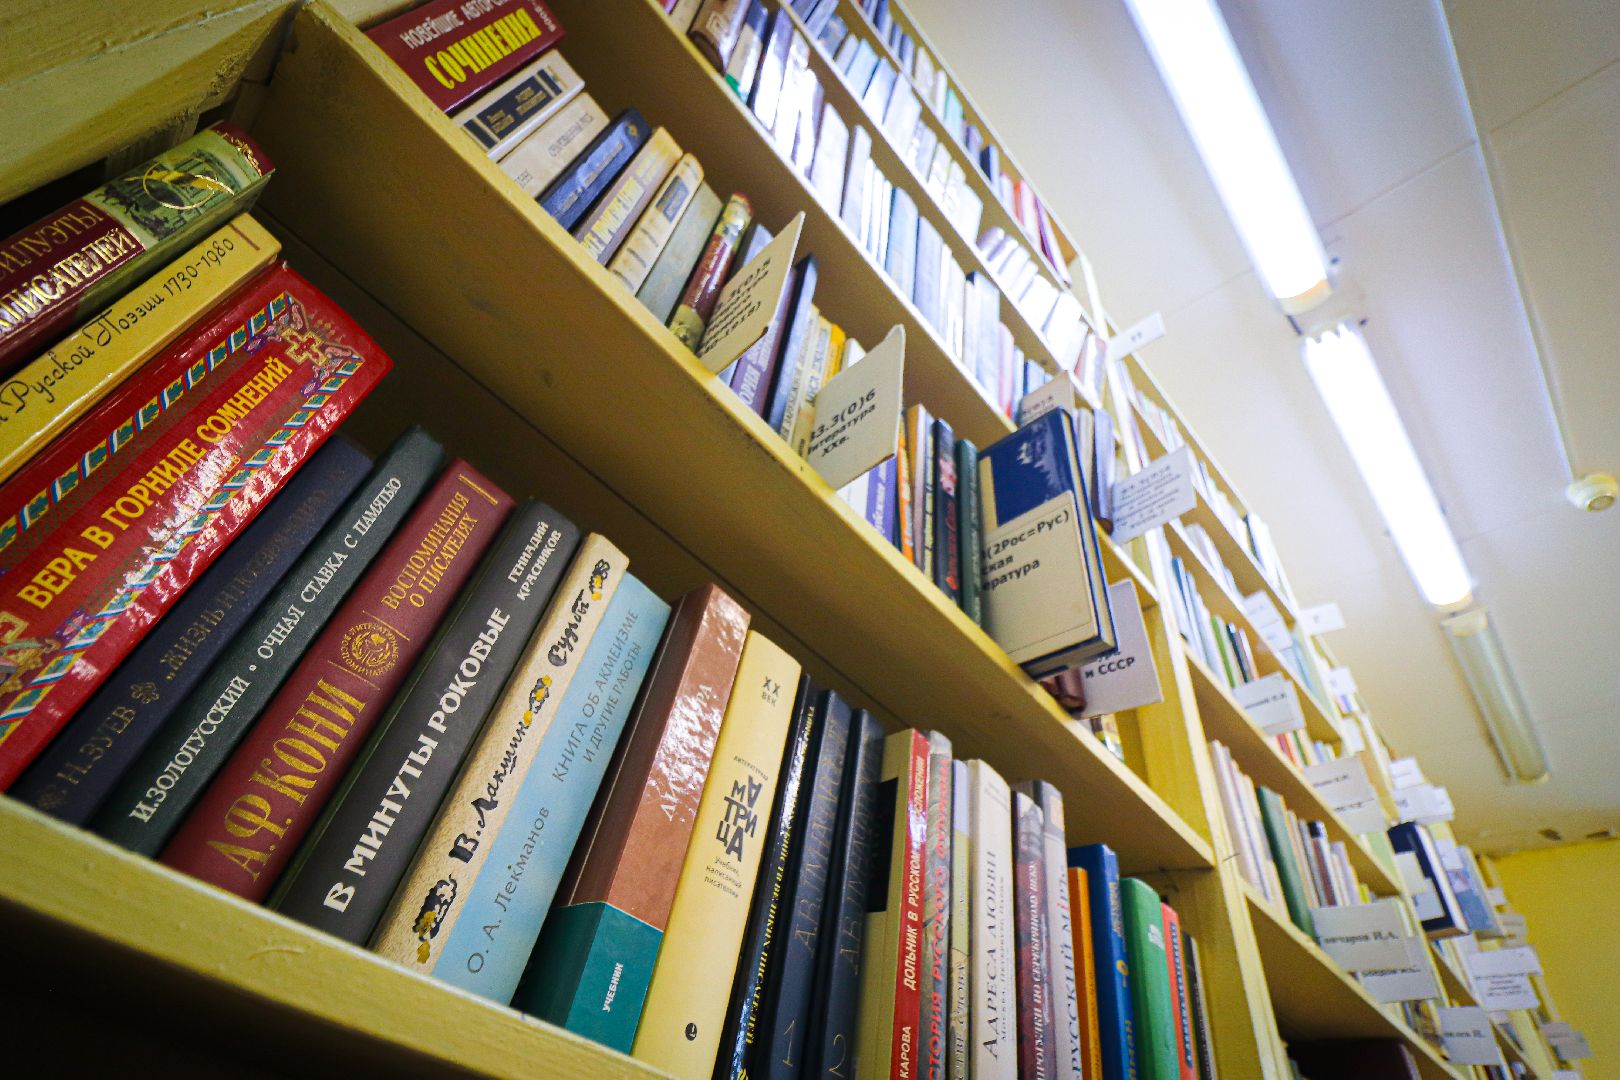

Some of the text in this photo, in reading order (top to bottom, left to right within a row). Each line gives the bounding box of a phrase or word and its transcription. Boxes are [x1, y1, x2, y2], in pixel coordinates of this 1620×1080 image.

[399, 10, 464, 50] НОВЕЙШИЕ
[424, 7, 542, 89] СОЧИНЕНИЯ
[0, 227, 136, 324] ПИСАТЕЛЕЙ
[0, 238, 235, 414] Русской Поэзии 1730-1980
[17, 358, 293, 610] ВЕРА В ГОРНИЛЕ СОМНЕНИЙ
[381, 491, 471, 610] ВОСПОМИНАНИЯ
[409, 514, 479, 609] О ПИСАТЕЛЯХ
[507, 520, 550, 585] ГЕННАДИЙ
[516, 529, 562, 603] КРАСНИКОВ
[129, 674, 251, 824] И.ЗОЛОТУССКИЙ
[256, 601, 306, 660] ОЧНАЯ
[300, 549, 349, 604] СТАВКА
[344, 533, 358, 549] С
[352, 476, 403, 537] ПАМЯТЬЮ
[1097, 655, 1136, 677] СССР
[552, 609, 641, 784] КНИГА ОБ АКМЕИЗМЕ
[583, 643, 644, 765] И ДРУГИЕ РАБОТЫ
[761, 690, 777, 708] ВЕК
[248, 678, 367, 808] КОНИ
[323, 606, 513, 913] В МИНУТЫ РОКОВЫЕ
[715, 820, 745, 863] ЦА
[724, 796, 758, 838] ТРИ
[908, 849, 922, 908] РУССКОМ
[909, 910, 920, 923] В
[466, 951, 490, 977] О.
[483, 916, 505, 942] А.
[902, 923, 919, 992] ДОЛЬНИК
[931, 866, 948, 982] РУССКОГО
[982, 851, 998, 1061] АДРЕСА ЛЮБВИ
[602, 962, 625, 1014] УЧЕБНИК
[1061, 943, 1081, 1075] РУССКИЙ
[782, 1018, 796, 1067] 1
[828, 1033, 846, 1079] 2
